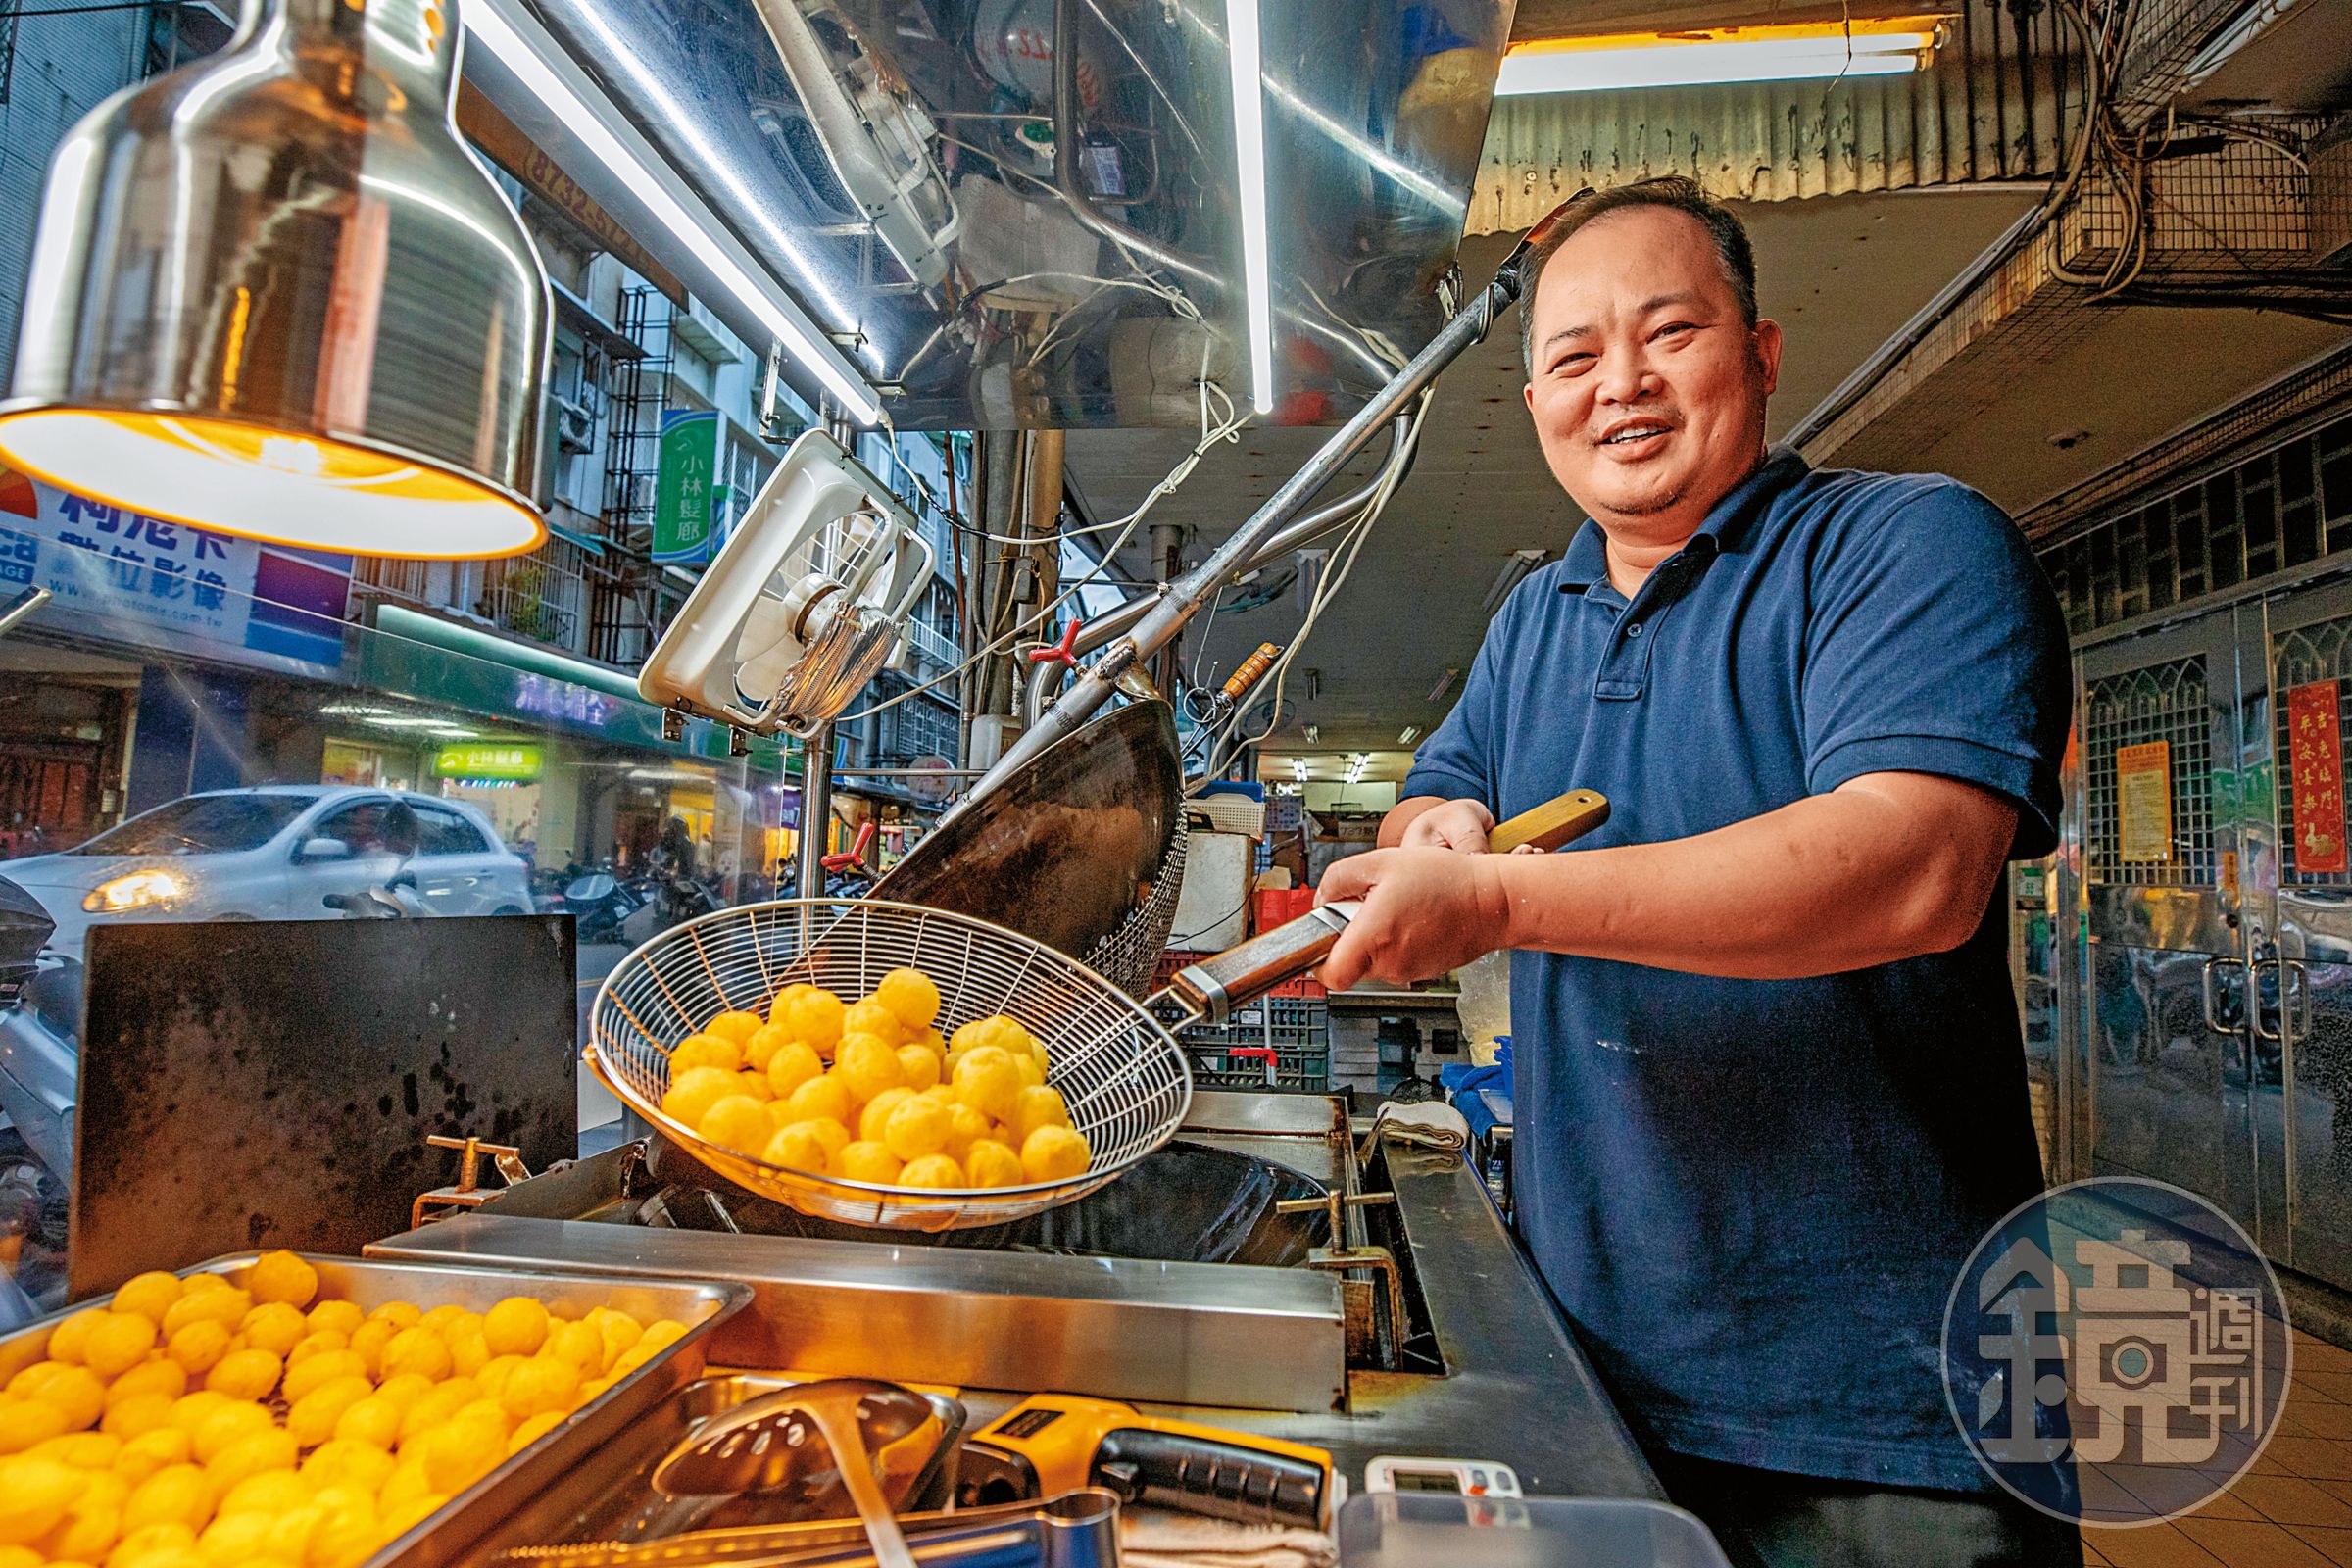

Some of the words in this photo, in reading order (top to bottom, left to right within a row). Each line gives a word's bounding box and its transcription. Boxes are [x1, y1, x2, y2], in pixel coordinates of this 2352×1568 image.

[677, 454, 704, 542] 小林髮廊
[2299, 714, 2318, 811] 平安喜樂
